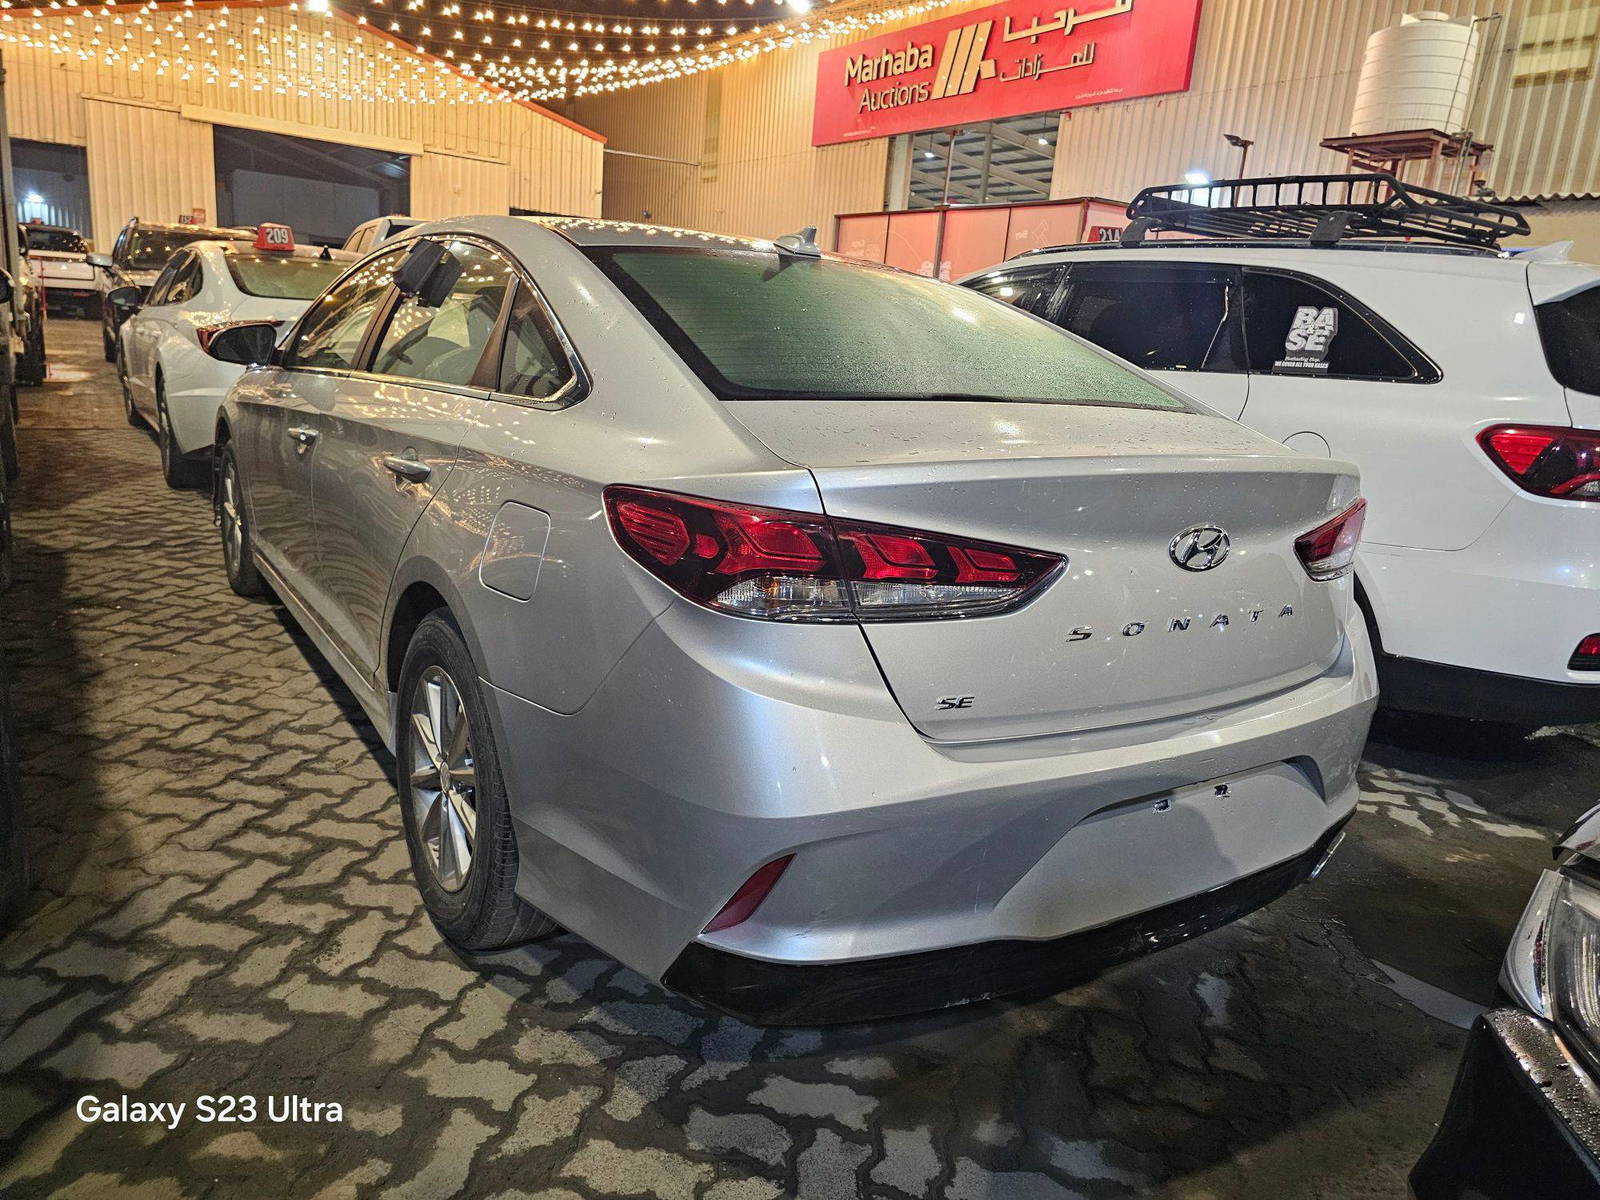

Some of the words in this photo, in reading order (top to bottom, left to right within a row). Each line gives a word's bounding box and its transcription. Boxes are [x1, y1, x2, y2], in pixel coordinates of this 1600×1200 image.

[843, 41, 934, 87] Marhaba
[858, 81, 930, 114] Auctions
[266, 228, 289, 244] 209
[1066, 604, 1293, 642] SONATA
[936, 696, 975, 711] SE
